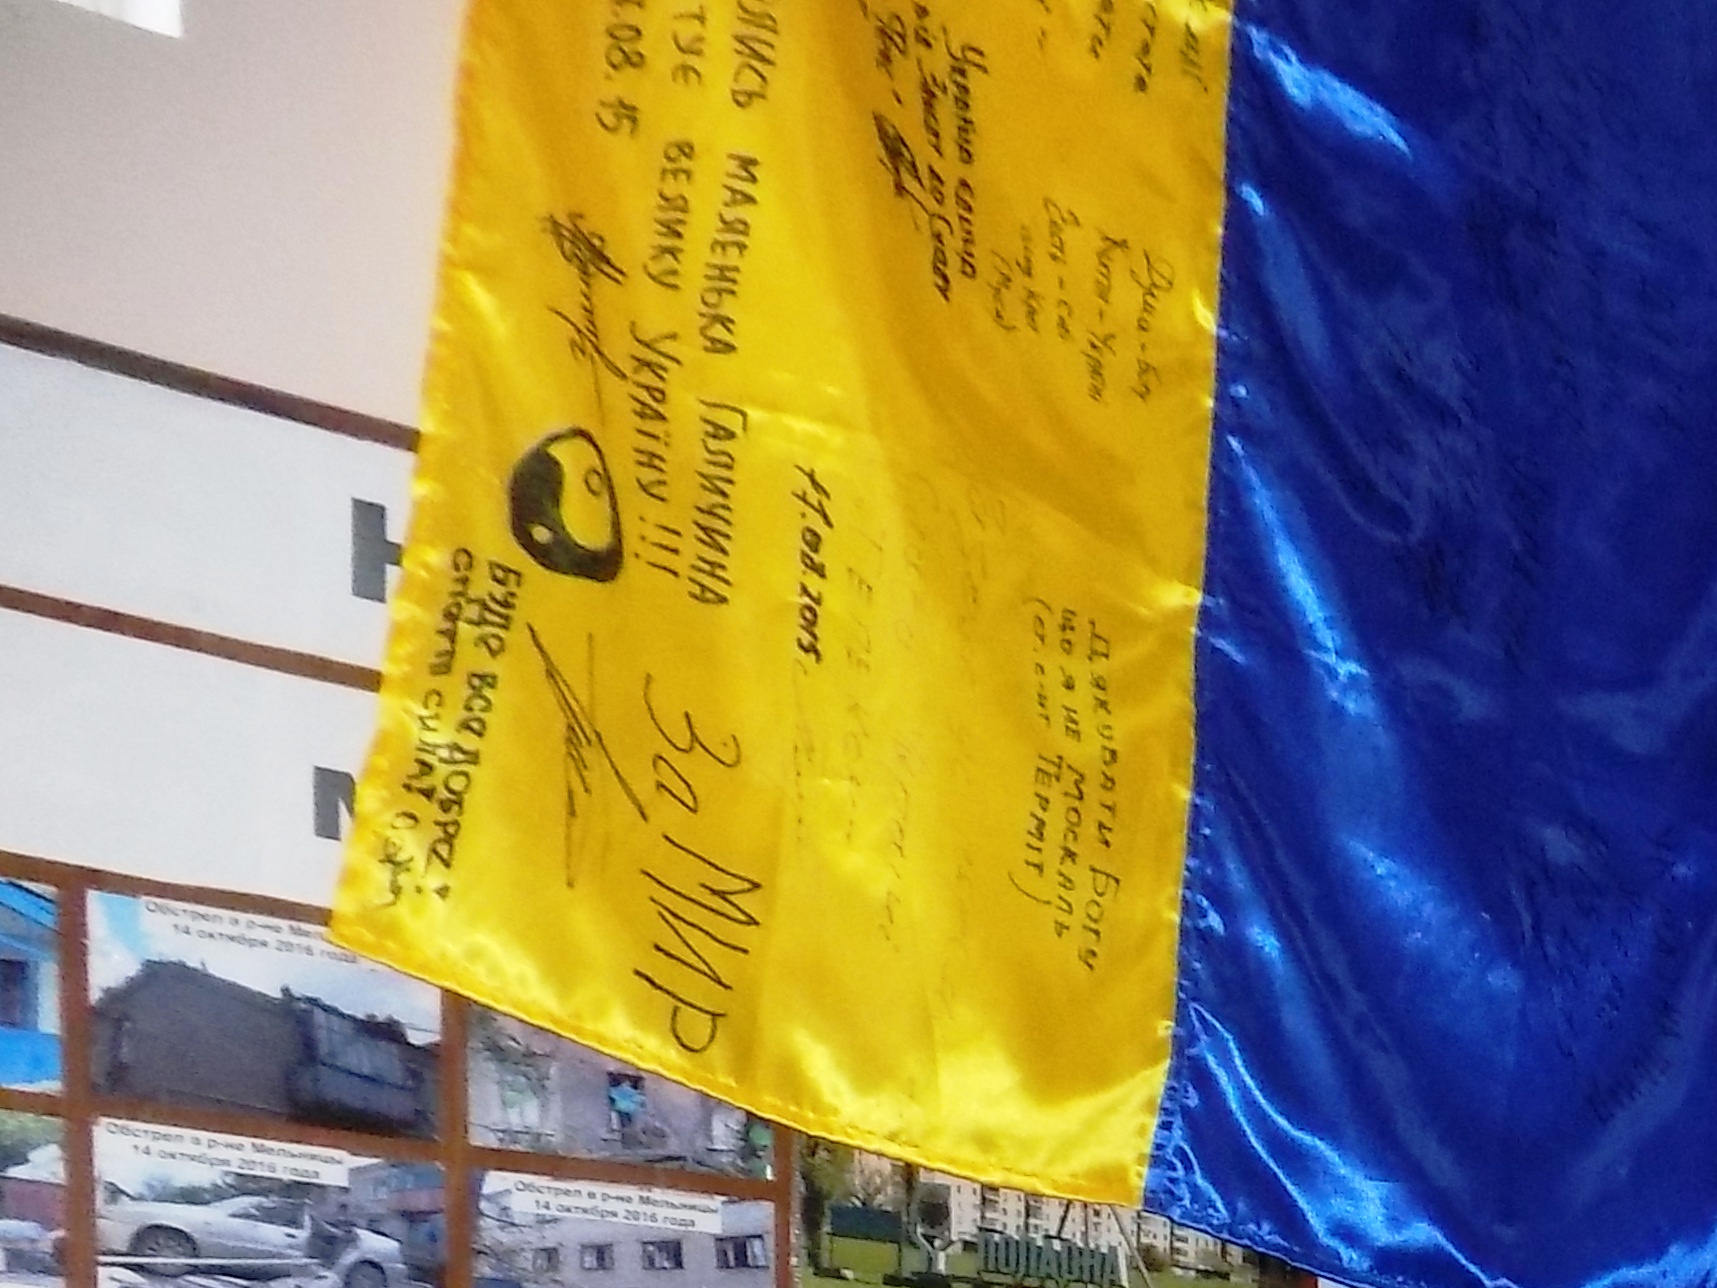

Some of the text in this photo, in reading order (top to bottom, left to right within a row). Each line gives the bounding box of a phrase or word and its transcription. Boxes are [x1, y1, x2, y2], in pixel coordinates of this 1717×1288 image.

[646, 140, 696, 291] ВЕЛИКУ
[699, 152, 763, 354] МАЛЕНЬКА
[687, 396, 749, 607] ГАЛИЧИНА
[633, 834, 762, 1055] МИР
